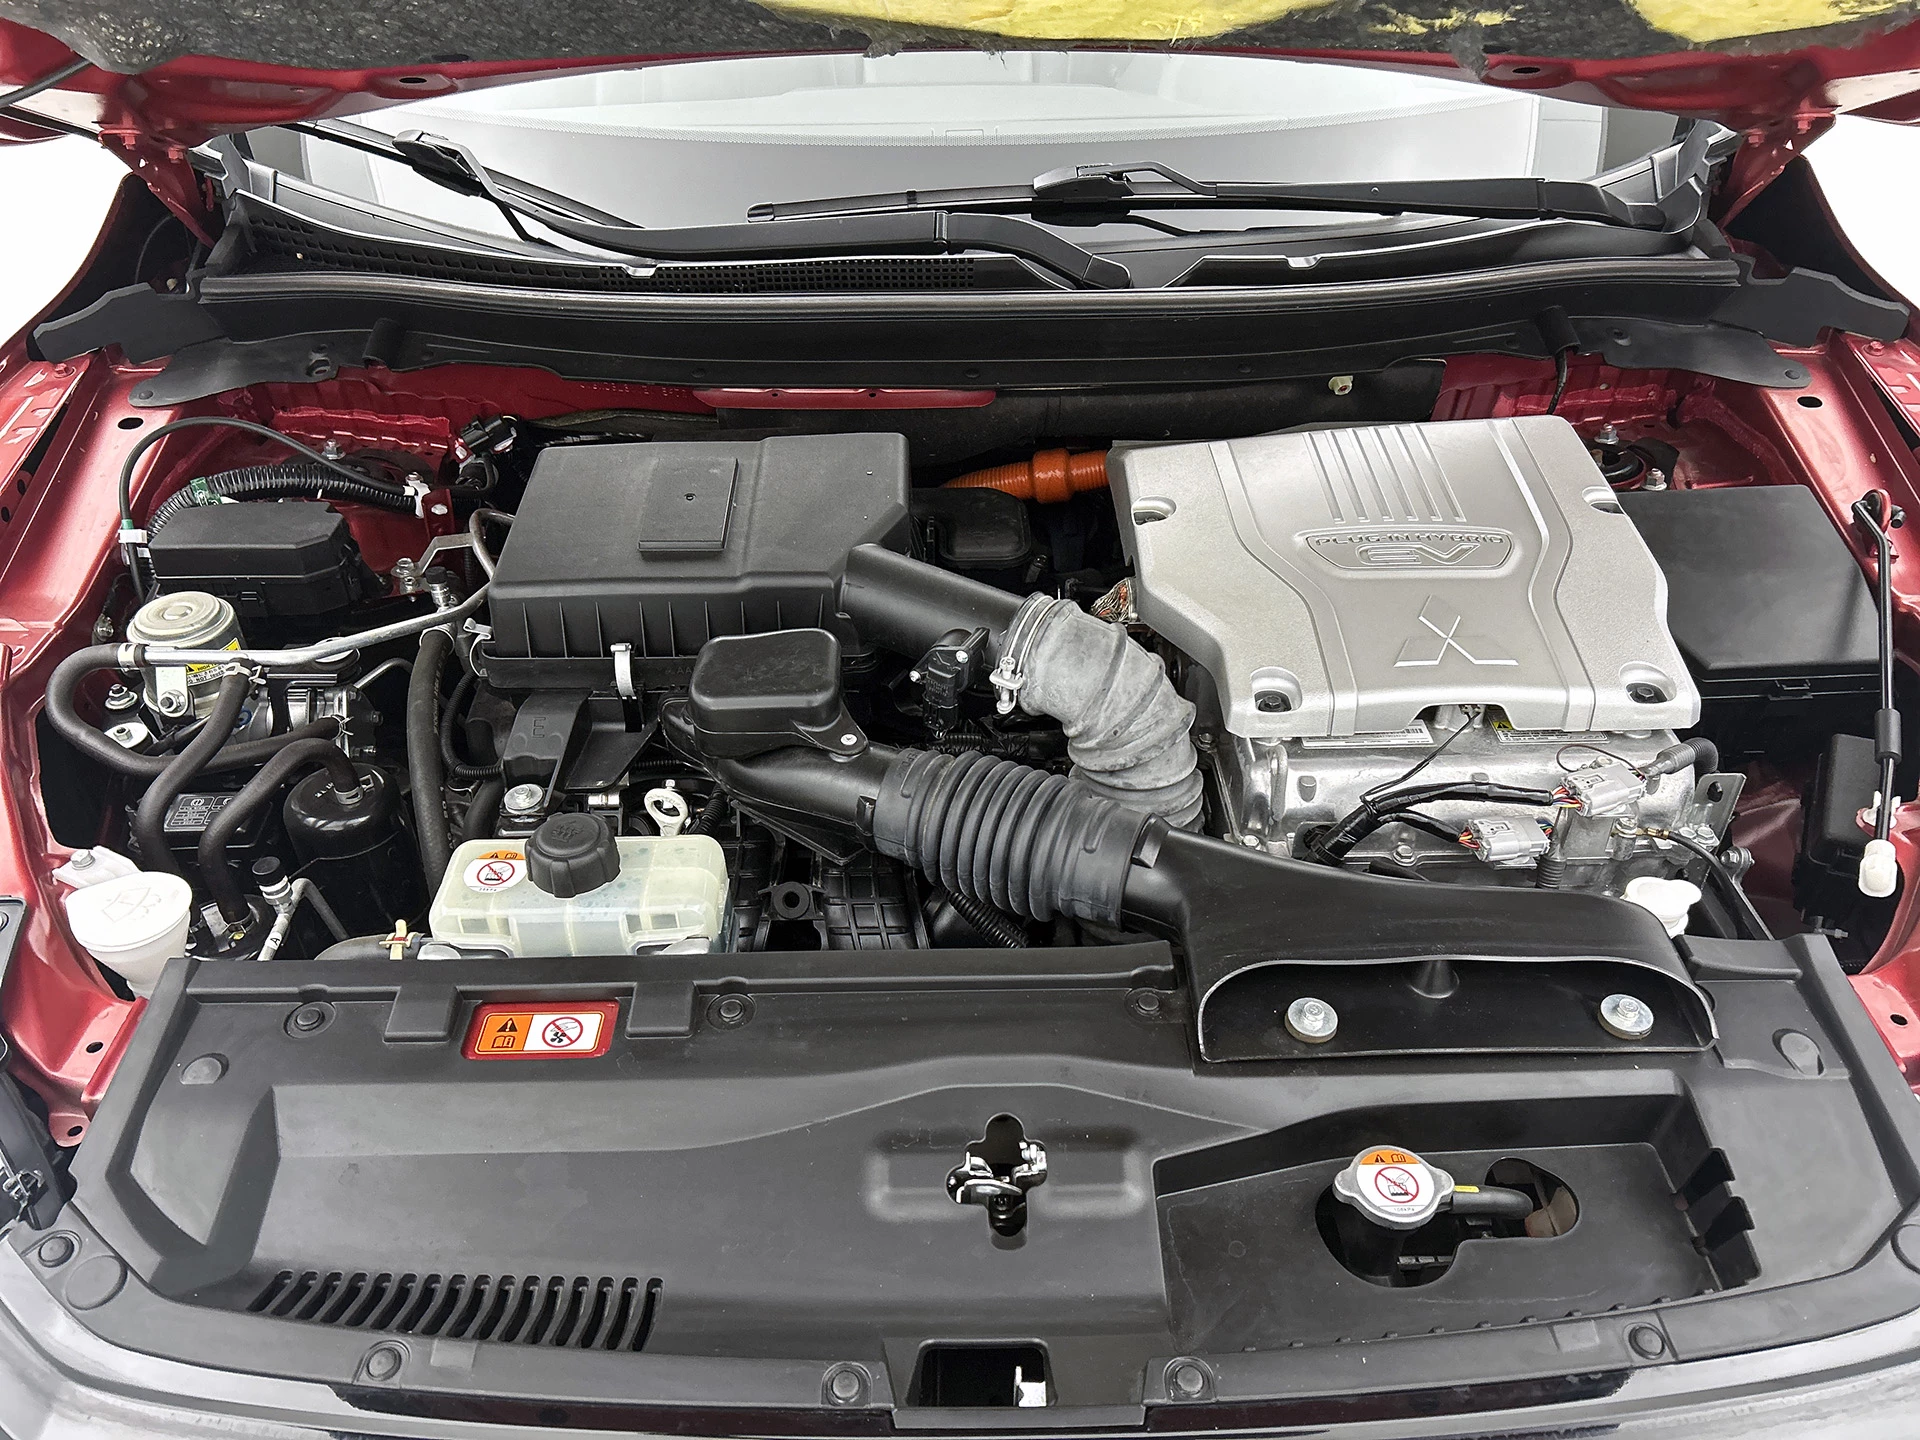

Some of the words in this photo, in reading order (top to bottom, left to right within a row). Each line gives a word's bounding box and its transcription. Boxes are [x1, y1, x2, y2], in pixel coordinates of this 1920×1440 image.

[1316, 534, 1411, 545] PLUG-IN
[1417, 533, 1504, 544] HYBRID
[1357, 542, 1480, 565] EV
[532, 717, 546, 738] E
